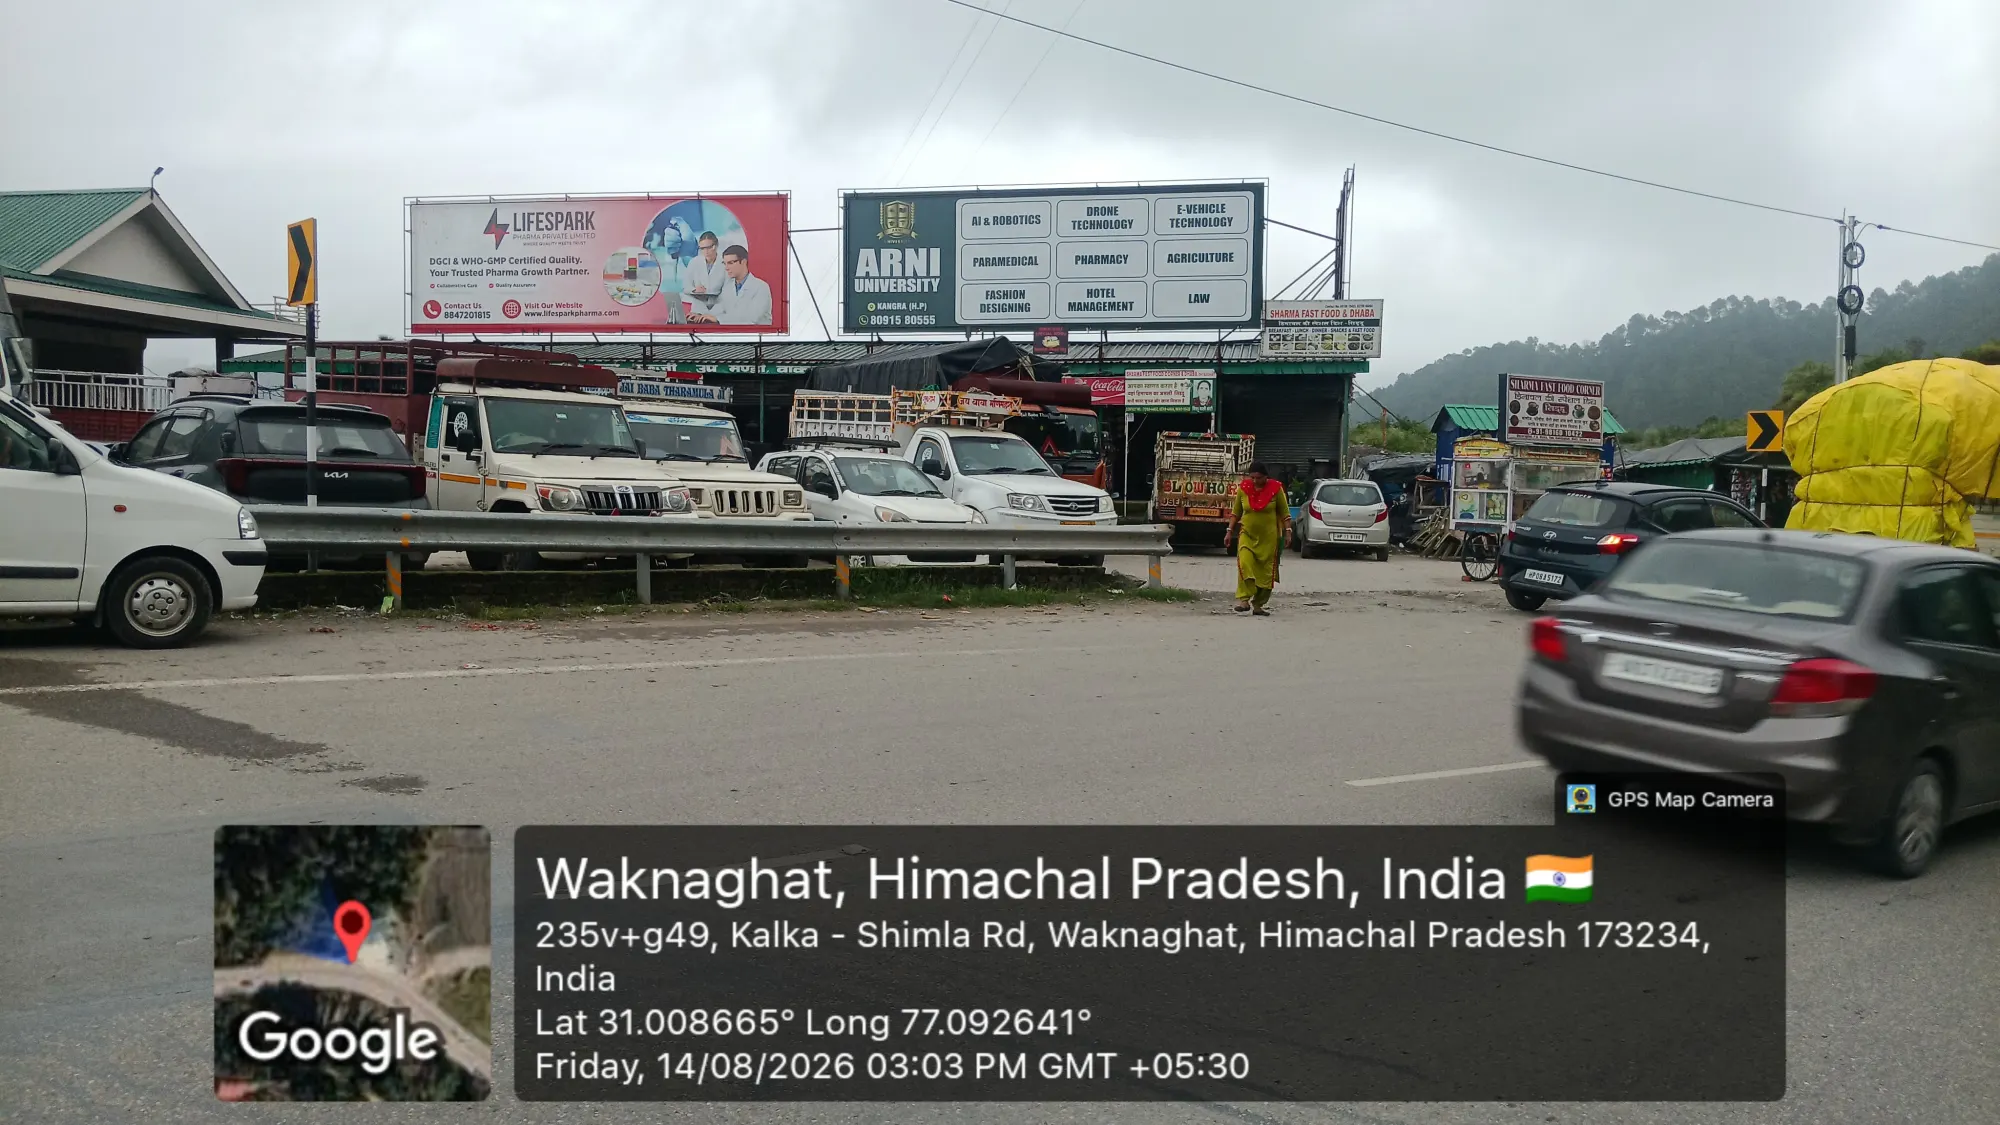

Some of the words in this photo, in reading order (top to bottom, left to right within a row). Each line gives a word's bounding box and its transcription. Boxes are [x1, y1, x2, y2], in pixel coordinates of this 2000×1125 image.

[1086, 206, 1119, 217] DRONE
[1177, 204, 1226, 215] E-VEHICLE
[513, 211, 595, 232] LIFESPARK
[971, 216, 982, 226] AI
[984, 216, 991, 226] &
[992, 214, 1041, 226] ROBOTICS
[1071, 218, 1134, 230] TECHNOLOGY
[1169, 216, 1234, 229] TECHNOLOGY
[429, 257, 451, 265] DGCI
[453, 257, 459, 265] &
[461, 256, 506, 265] WHO-GMP
[508, 256, 546, 265] Certified
[548, 255, 583, 265] Quality.
[855, 247, 941, 277] ARNI
[973, 256, 1039, 267] PARAMEDICAL
[1074, 254, 1129, 265] PHARMACY
[1166, 252, 1235, 264] AGRICULTURE
[429, 269, 449, 277] Your
[451, 268, 483, 277] Trusted
[485, 268, 519, 277] Pharma
[521, 267, 552, 276] Growth
[555, 267, 590, 276] Partner.
[854, 278, 940, 293] UNIVERSITY
[985, 289, 1026, 300] FASHION
[1086, 288, 1116, 299] HOTEL
[1188, 293, 1211, 304] LAW
[877, 302, 907, 310] KANGRA
[909, 302, 927, 311] (H.P)
[979, 302, 1031, 313] DESIGNING
[1067, 301, 1134, 312] MANAGEMENT
[444, 311, 491, 319] 8847201815
[524, 309, 620, 318] www.lifesparkpharma.com
[1270, 309, 1299, 318] SHARMA
[1301, 309, 1319, 318] FAST
[1321, 309, 1341, 317] FOOD
[1342, 309, 1347, 317] &
[1349, 309, 1375, 317] DHABA
[870, 315, 901, 325] 80915
[904, 315, 936, 325] 80555
[619, 381, 634, 393] JAI
[637, 383, 660, 396] BABA
[717, 386, 727, 400] JI
[1510, 379, 1539, 393] SHARMA
[1540, 381, 1556, 393] FAST
[1557, 383, 1575, 394] FOOD
[1576, 384, 1600, 396] CORNER
[958, 397, 970, 406] जय
[1163, 479, 1204, 494] BLOW
[1206, 482, 1239, 496] HOR
